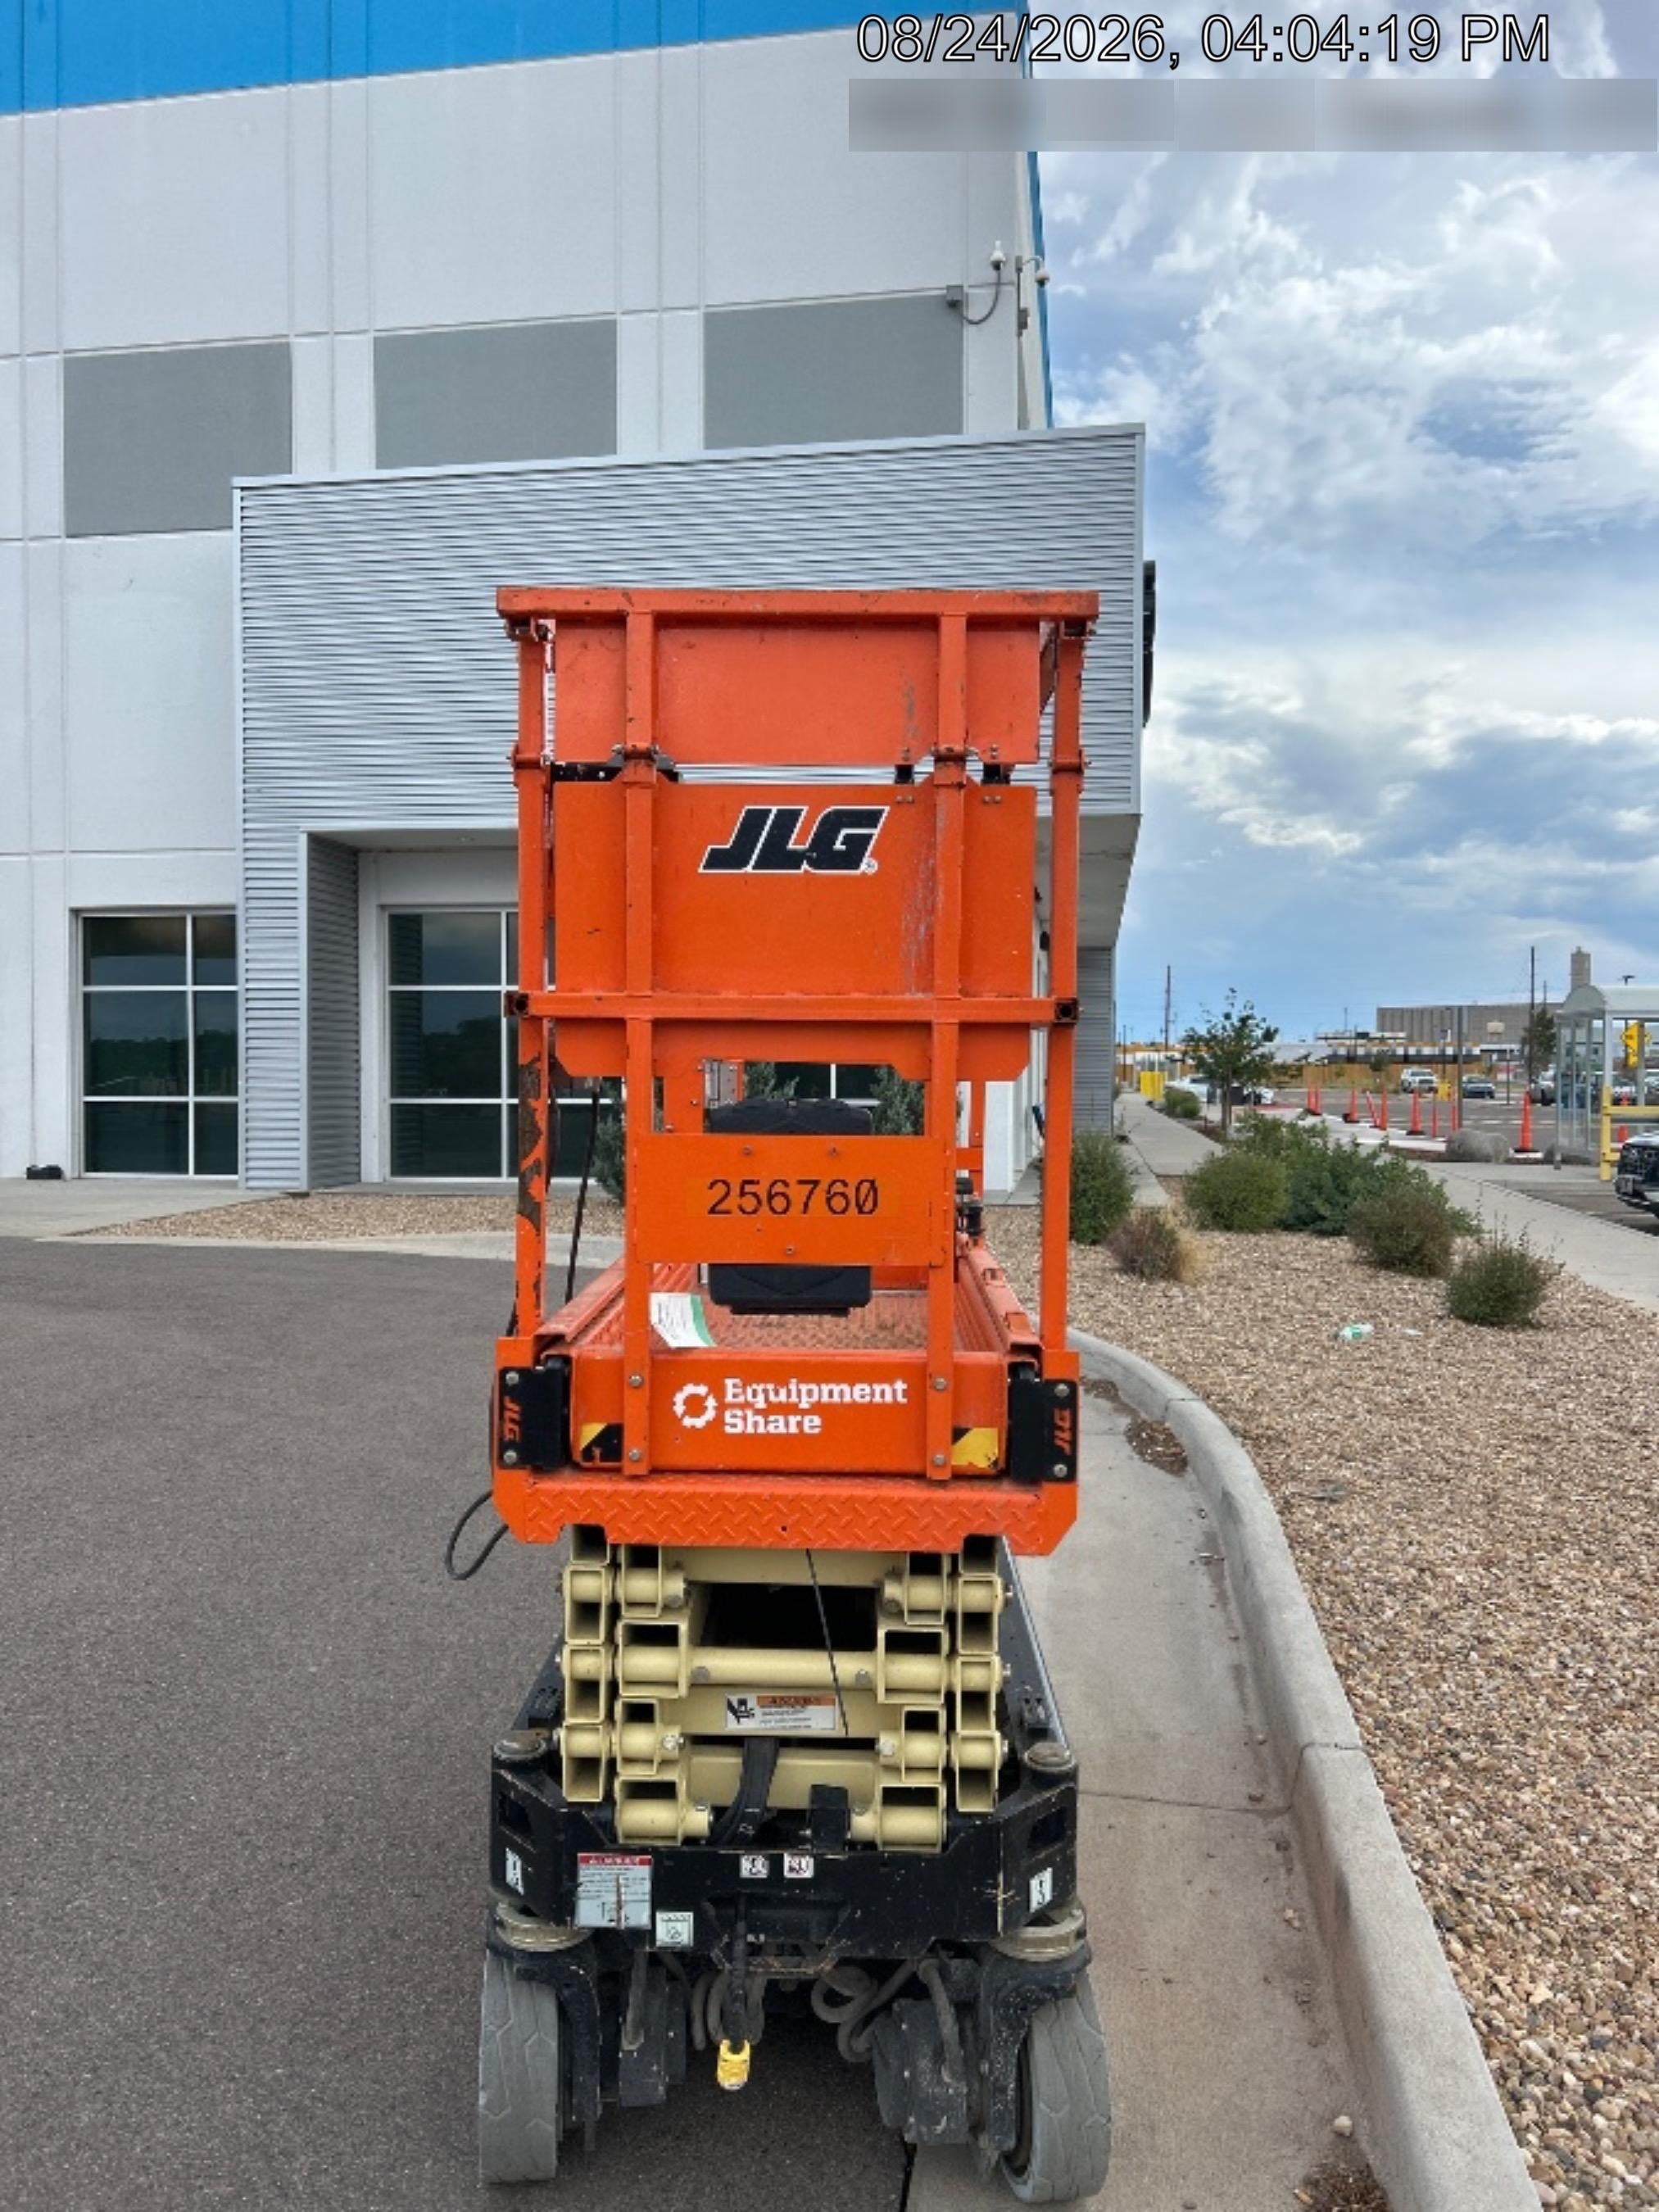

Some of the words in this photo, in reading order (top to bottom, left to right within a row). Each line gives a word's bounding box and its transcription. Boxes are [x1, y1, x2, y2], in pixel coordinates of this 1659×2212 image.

[698, 805, 891, 874] JLG
[707, 1179, 879, 1215] 256760
[723, 1378, 908, 1409] Equipment
[504, 1395, 520, 1442] JLG
[723, 1409, 822, 1434] Share
[1054, 1407, 1072, 1456] JLG
